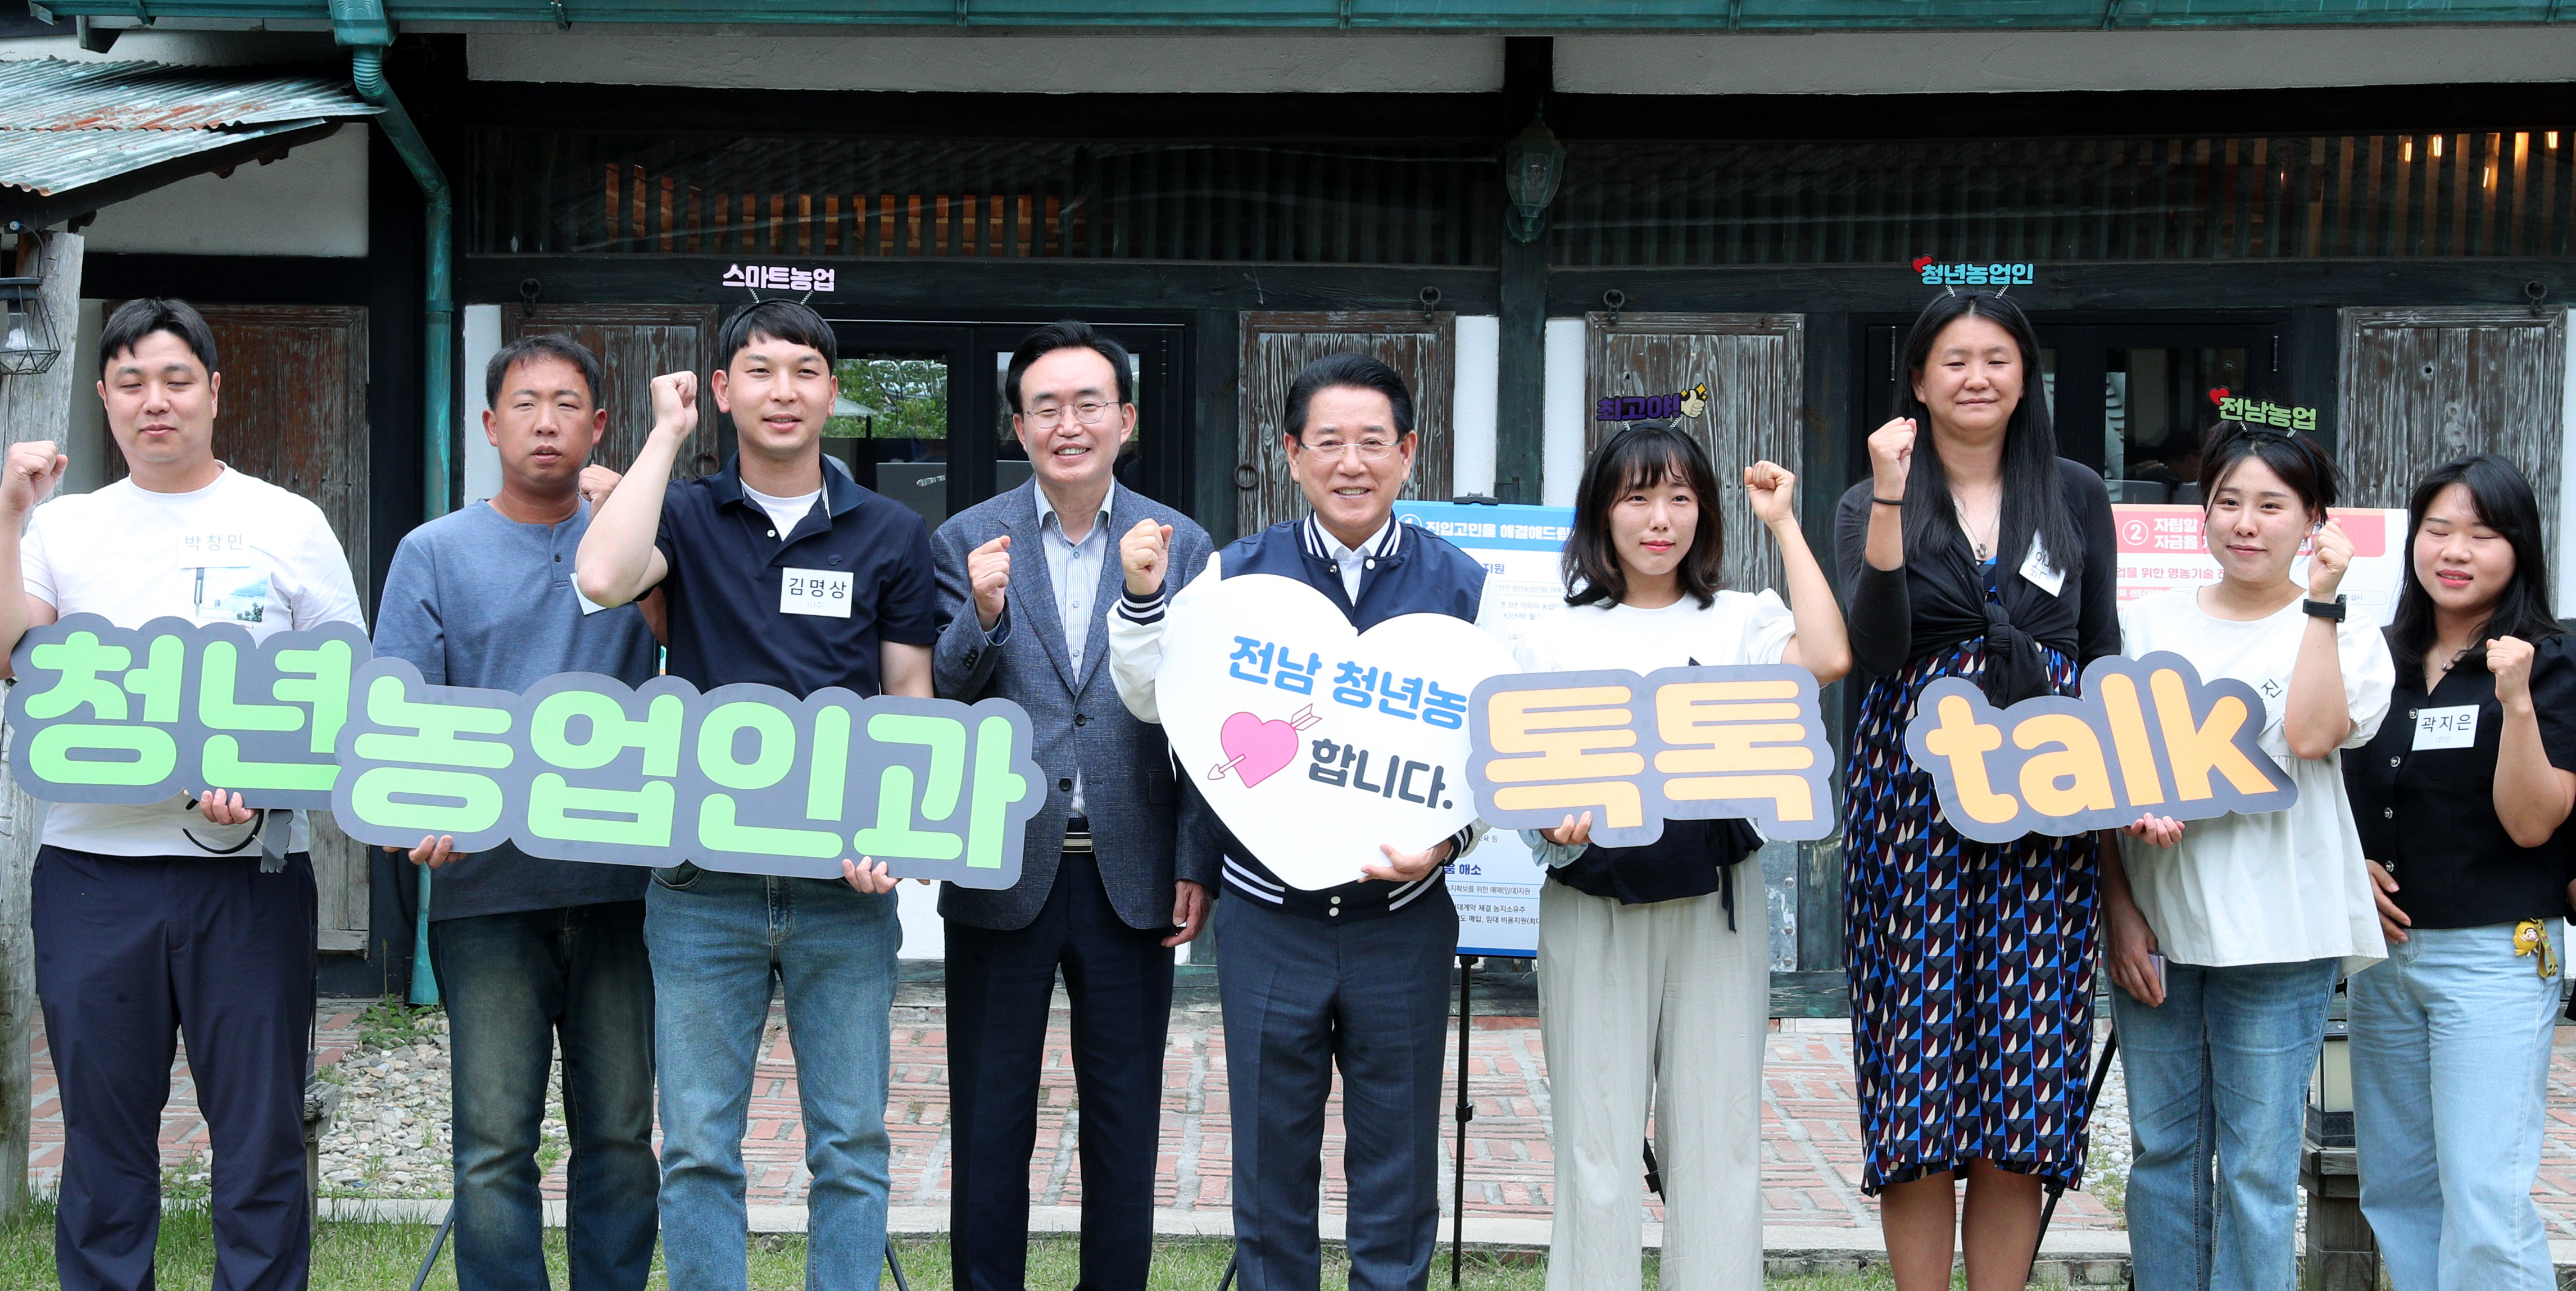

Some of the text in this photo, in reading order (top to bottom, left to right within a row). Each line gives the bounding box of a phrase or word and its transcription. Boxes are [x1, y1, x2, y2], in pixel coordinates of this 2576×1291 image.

[722, 263, 835, 292] 스마트농업
[1921, 262, 2034, 285] 청년농업인
[1596, 393, 1681, 421] 최고야!
[2219, 397, 2316, 431] 전남농업
[1425, 521, 1496, 538] 진입고민을
[2154, 517, 2198, 533] 자립할
[185, 534, 243, 551] 박창민
[2154, 535, 2198, 549] 자금을
[2141, 567, 2165, 579] 위한
[2168, 568, 2214, 579] 영농기술
[788, 578, 847, 599] 김명상
[1229, 635, 1467, 730] 전남 청년농
[2421, 713, 2473, 733] 곽지은
[1484, 679, 1815, 829] 톡톡
[1925, 668, 2279, 824] talk
[1308, 738, 1453, 810] 합니다.
[1459, 864, 1482, 875] 해소
[1490, 887, 1531, 895] 매매(임대)지원
[1478, 904, 1491, 912] 체결
[1493, 905, 1526, 913] 농지소유주
